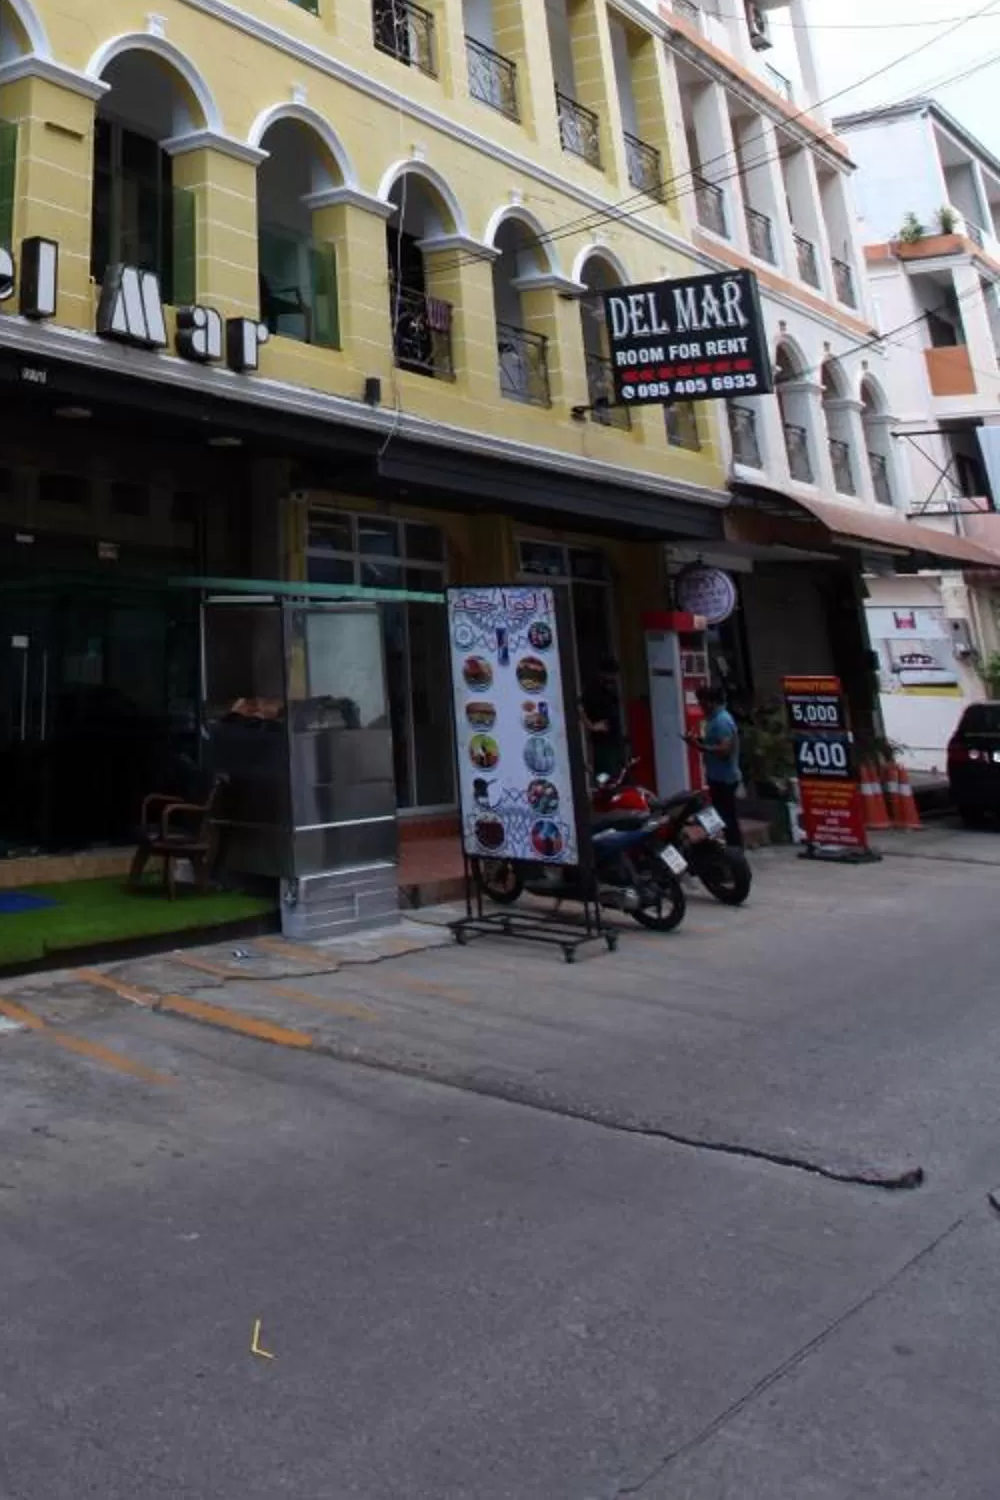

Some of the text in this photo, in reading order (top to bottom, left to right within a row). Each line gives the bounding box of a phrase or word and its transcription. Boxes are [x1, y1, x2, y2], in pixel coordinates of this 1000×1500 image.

[99, 262, 269, 371] Mar
[609, 281, 749, 340] DEL MAR
[616, 337, 748, 366] ROOM FOR RENT
[637, 373, 757, 398] 095 405 6933
[791, 704, 838, 723] 5,000
[799, 741, 847, 767] 400
